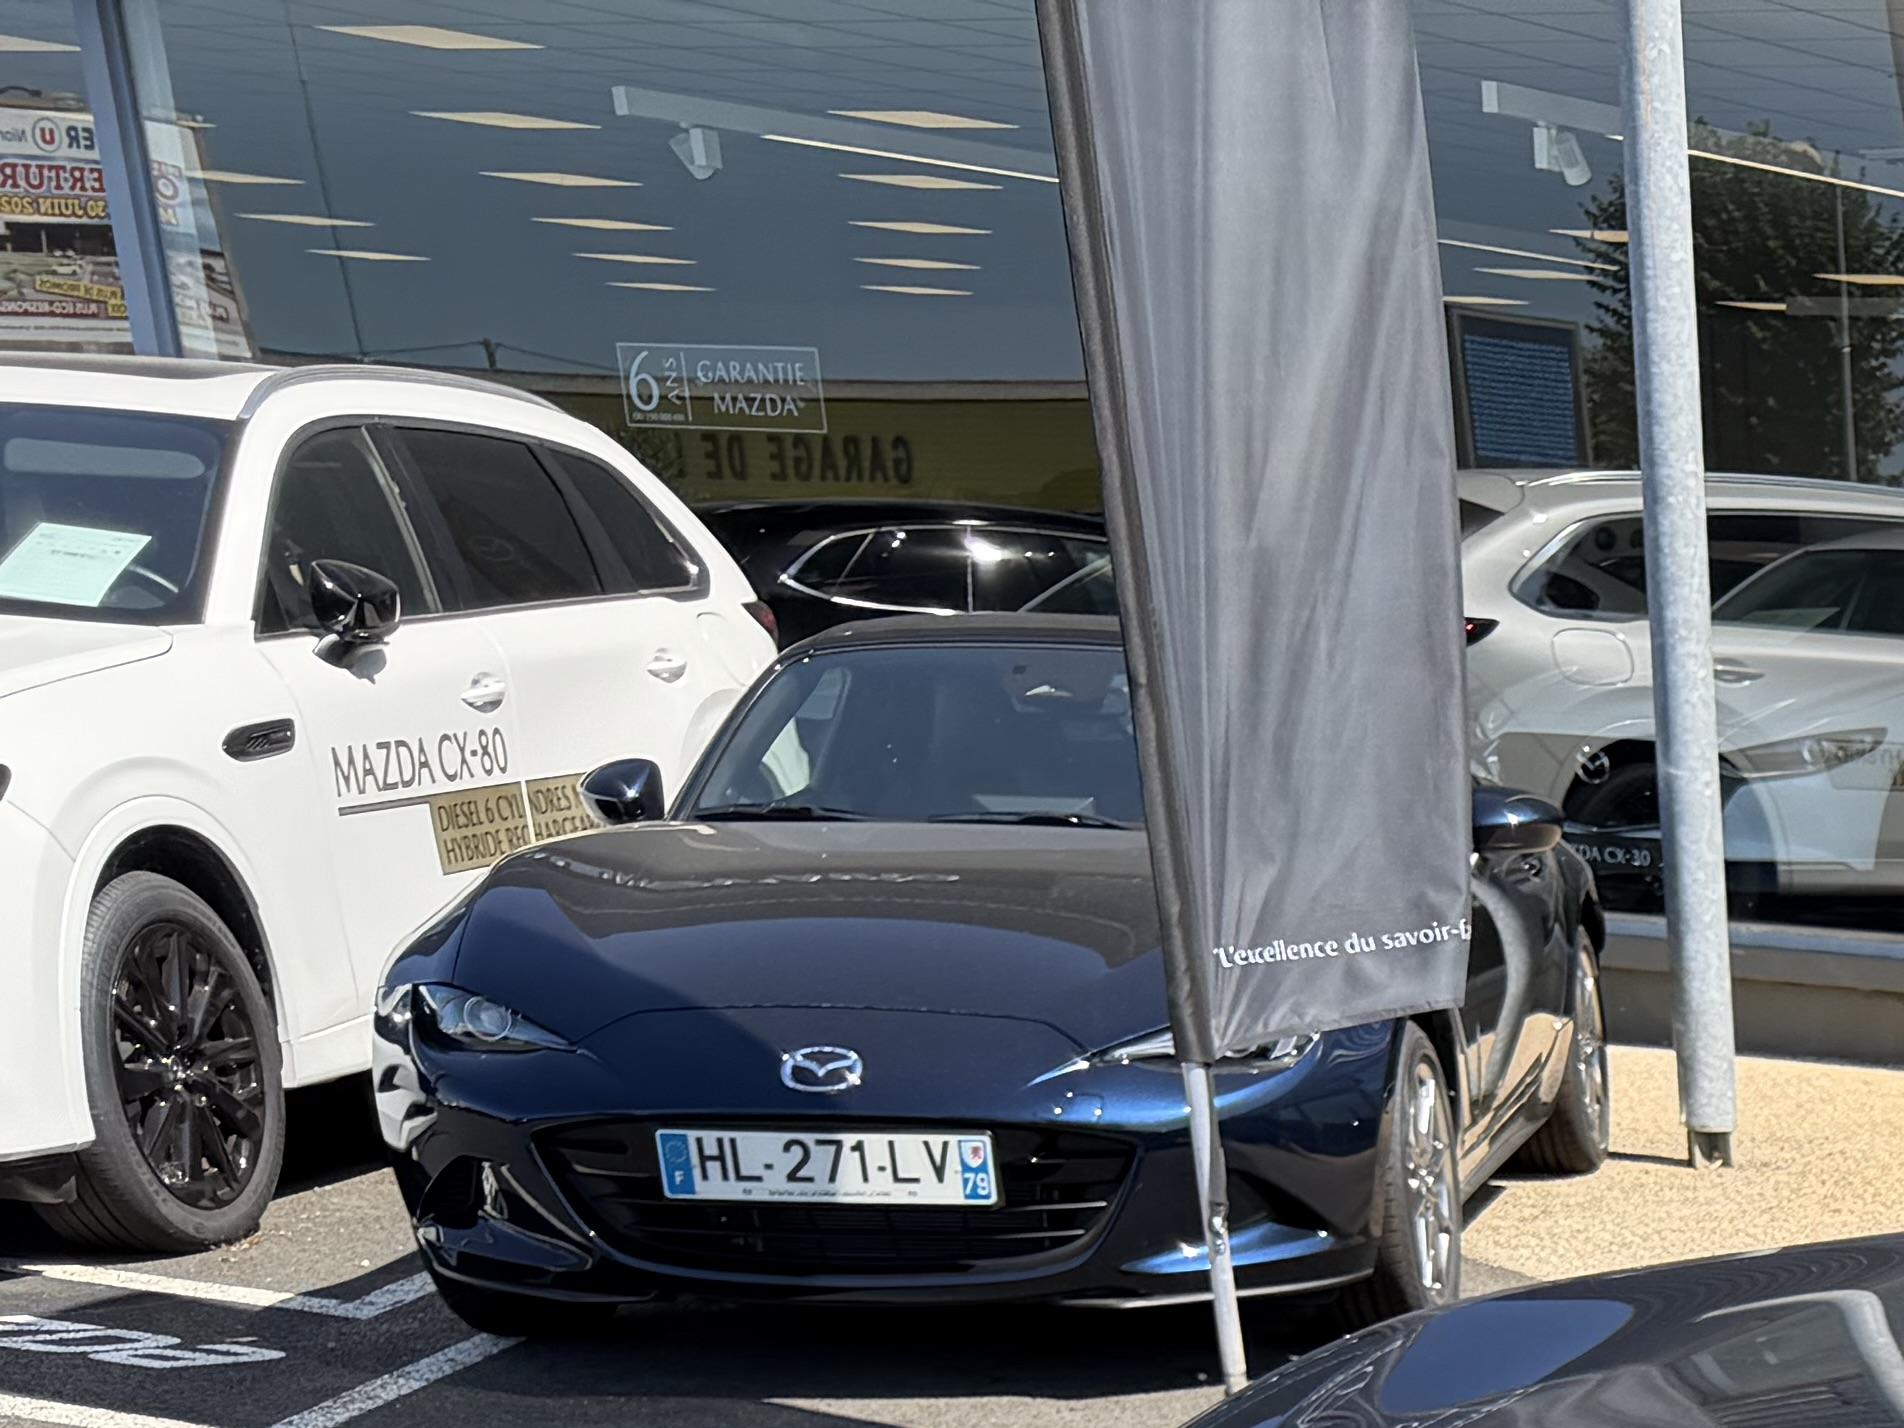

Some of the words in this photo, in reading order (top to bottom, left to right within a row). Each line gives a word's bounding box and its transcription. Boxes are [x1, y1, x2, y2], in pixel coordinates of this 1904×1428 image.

[628, 351, 661, 411] 6
[664, 357, 684, 405] ANS
[697, 360, 805, 385] GARANTIE
[712, 392, 799, 417] MAZDA
[331, 737, 436, 798] MAZDA
[437, 727, 509, 782] CX-80
[437, 799, 484, 833] DIESEL
[485, 797, 496, 824] 6
[443, 828, 507, 866] HYBRIDE
[1603, 847, 1652, 867] CX-30
[1344, 931, 1377, 954] du
[695, 1137, 950, 1184] HL-271-LV
[674, 1170, 685, 1185] F
[963, 1172, 990, 1197] 79
